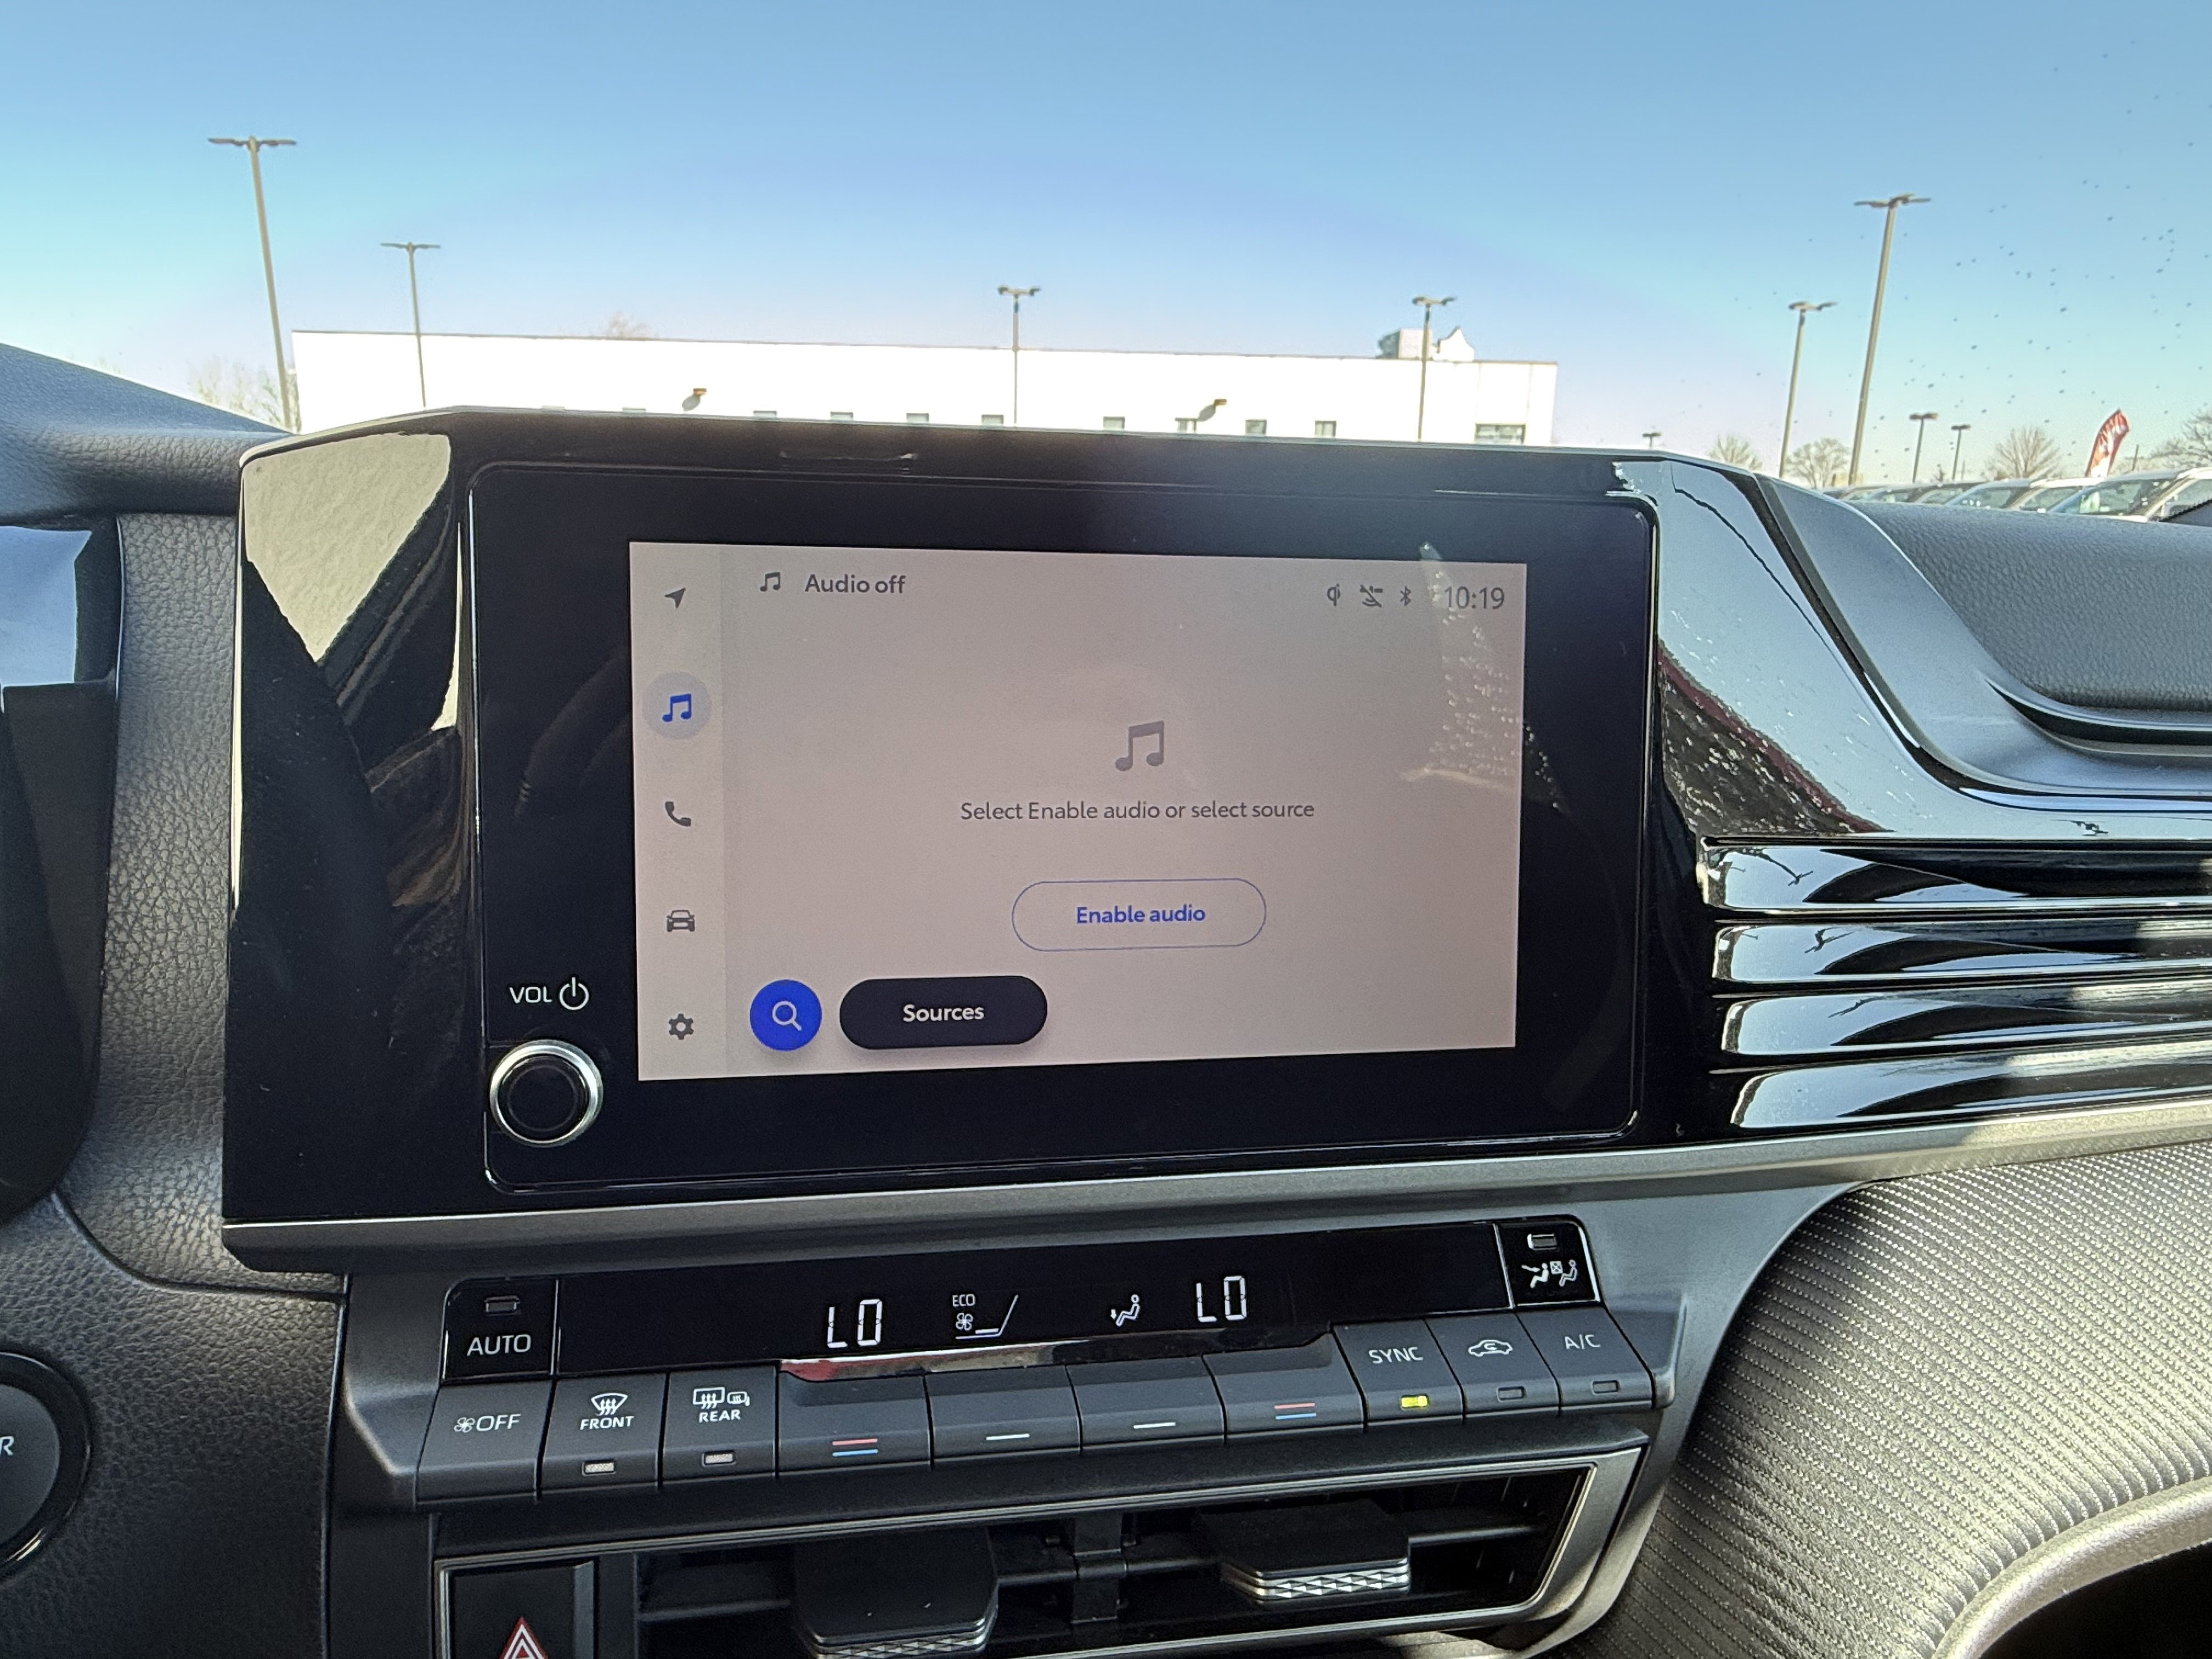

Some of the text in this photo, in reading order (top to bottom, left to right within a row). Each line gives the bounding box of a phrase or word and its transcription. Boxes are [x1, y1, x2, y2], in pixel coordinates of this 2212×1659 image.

[804, 573, 906, 594] Audio off
[1444, 585, 1505, 610] 10:19
[960, 800, 1315, 820] Select Enable audio or select source
[1076, 904, 1206, 924] Enable audio
[509, 986, 553, 1004] VOL
[902, 1003, 985, 1022] Sources
[952, 1294, 975, 1307] ECO
[467, 1334, 532, 1356] AUTO
[1565, 1334, 1601, 1350] A/C
[1368, 1347, 1423, 1364] SYNC
[476, 1413, 521, 1432] OFF
[579, 1415, 634, 1430] FRONT
[699, 1409, 741, 1423] REAR
